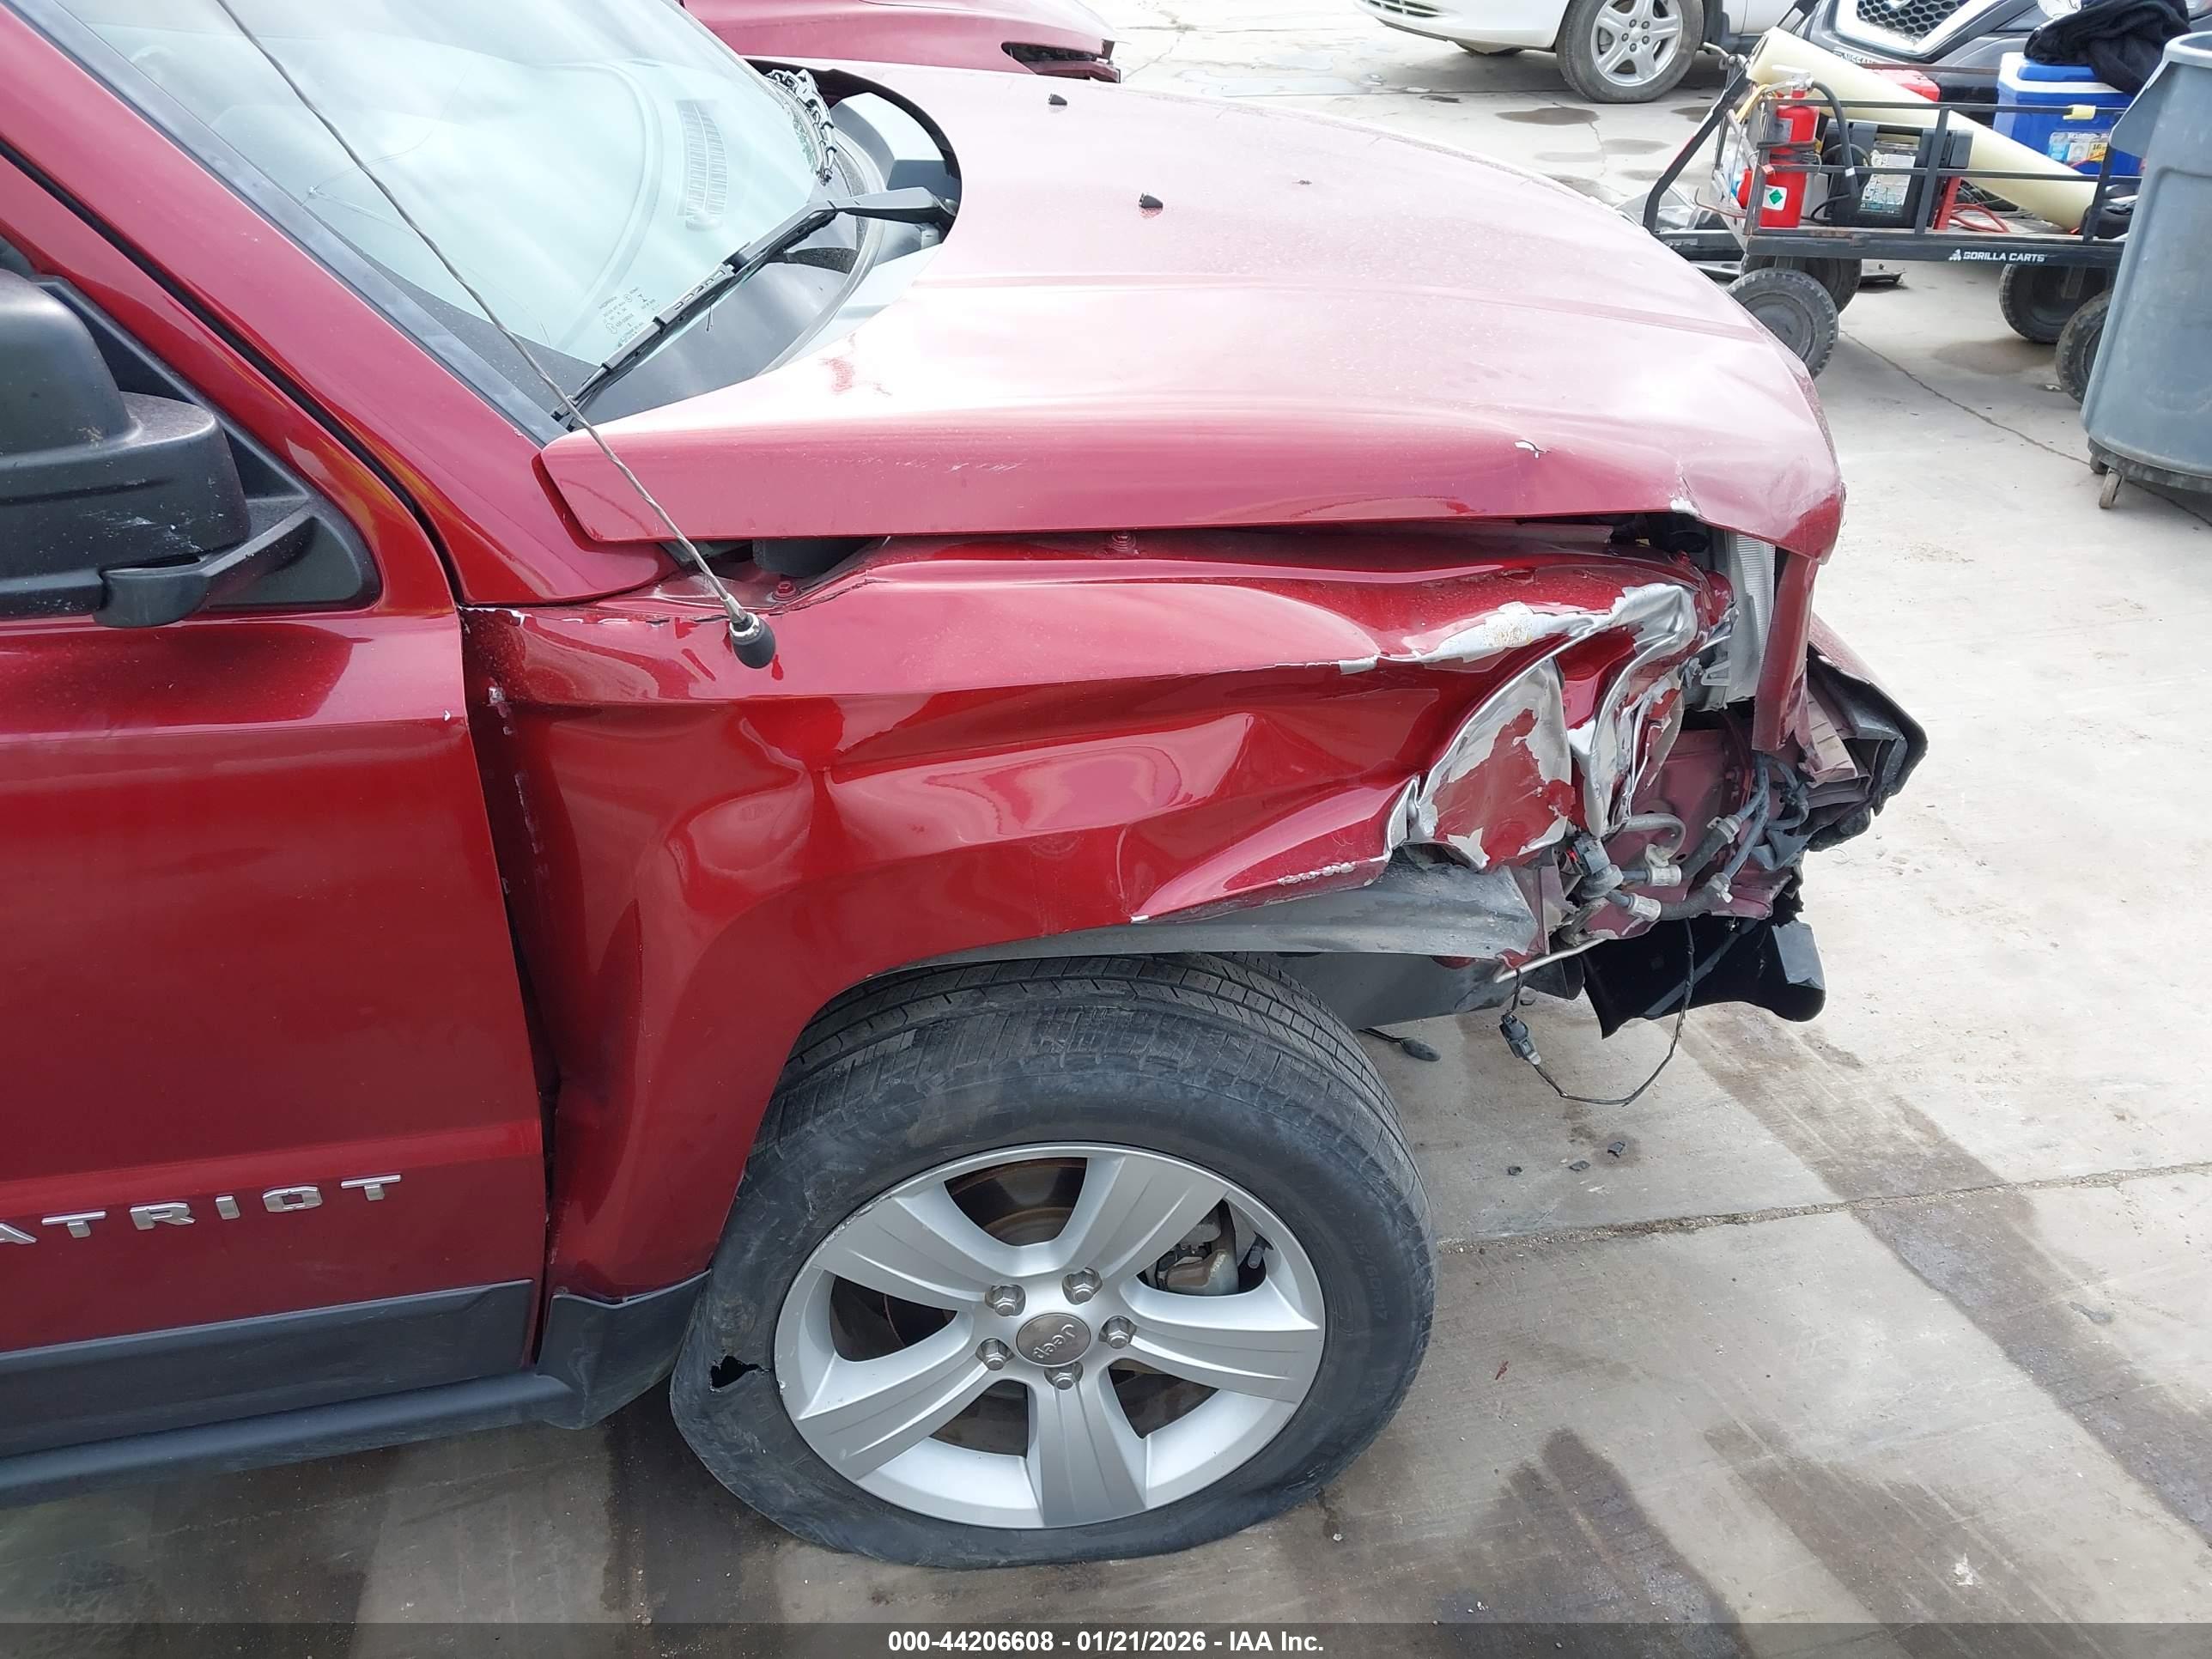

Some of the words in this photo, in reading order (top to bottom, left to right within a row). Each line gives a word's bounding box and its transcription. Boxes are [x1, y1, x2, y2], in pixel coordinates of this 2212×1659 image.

[1963, 252, 2007, 261] GORILLA
[2008, 252, 2045, 262] CARTS
[1031, 1323, 1079, 1359] Jeep
